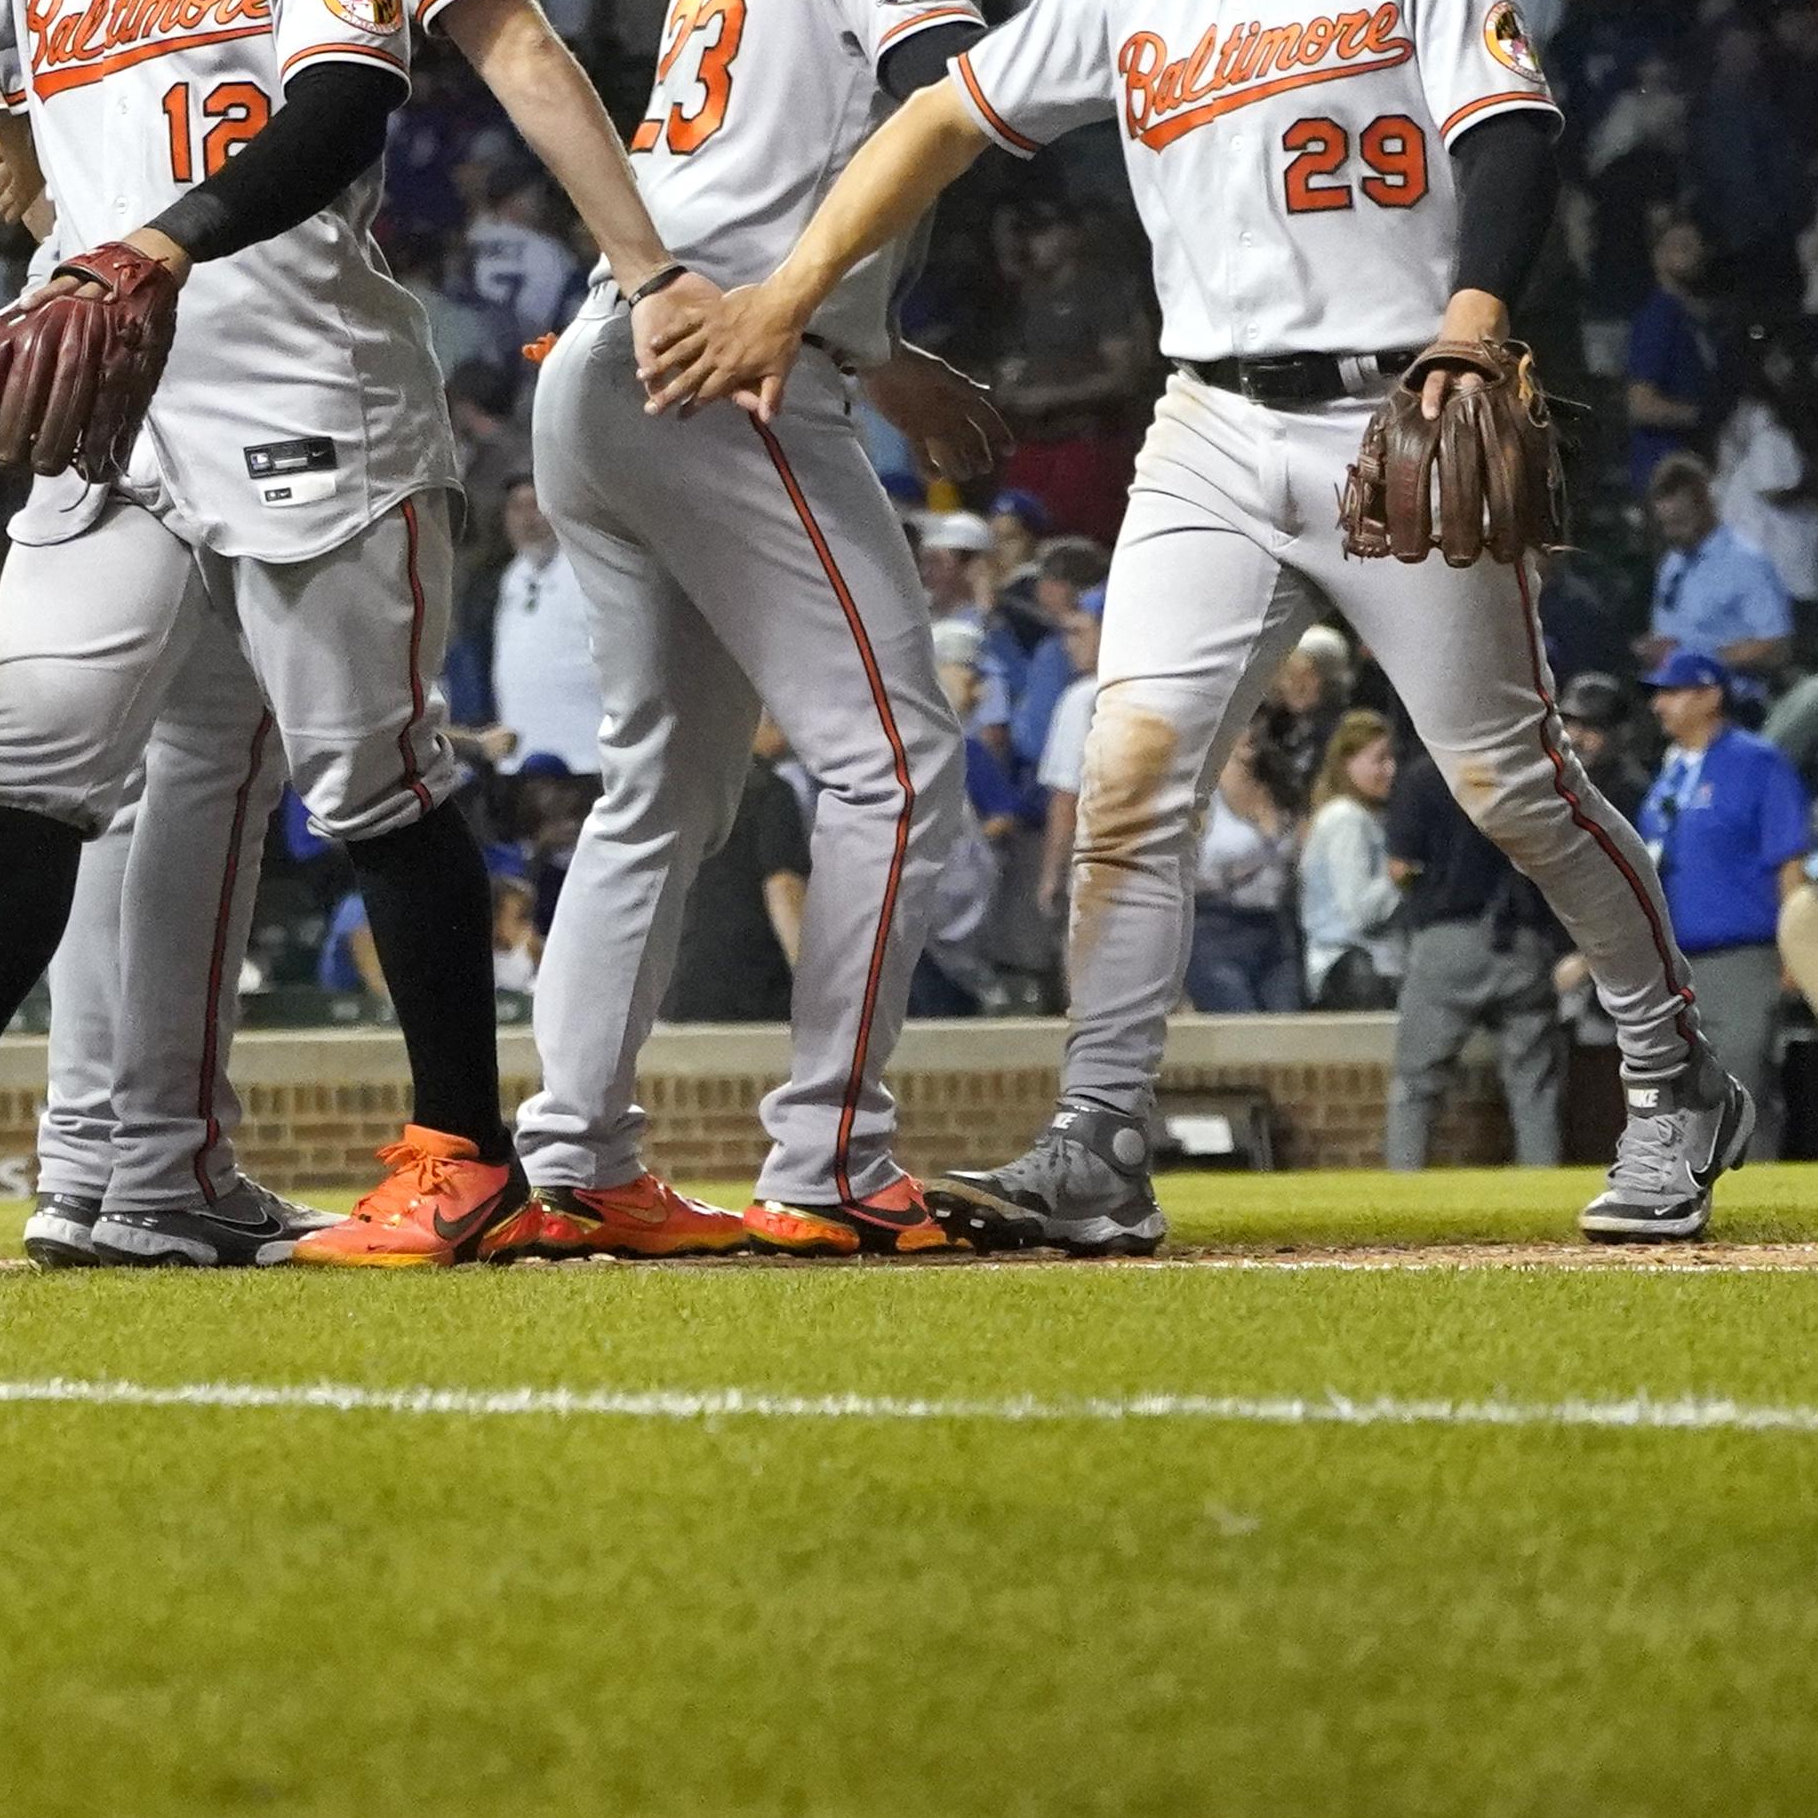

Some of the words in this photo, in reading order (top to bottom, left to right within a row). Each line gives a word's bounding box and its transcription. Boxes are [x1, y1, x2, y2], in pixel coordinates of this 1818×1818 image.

[1118, 2, 1414, 142] Baltimore
[161, 81, 272, 184] 12
[1282, 113, 1430, 215] 29
